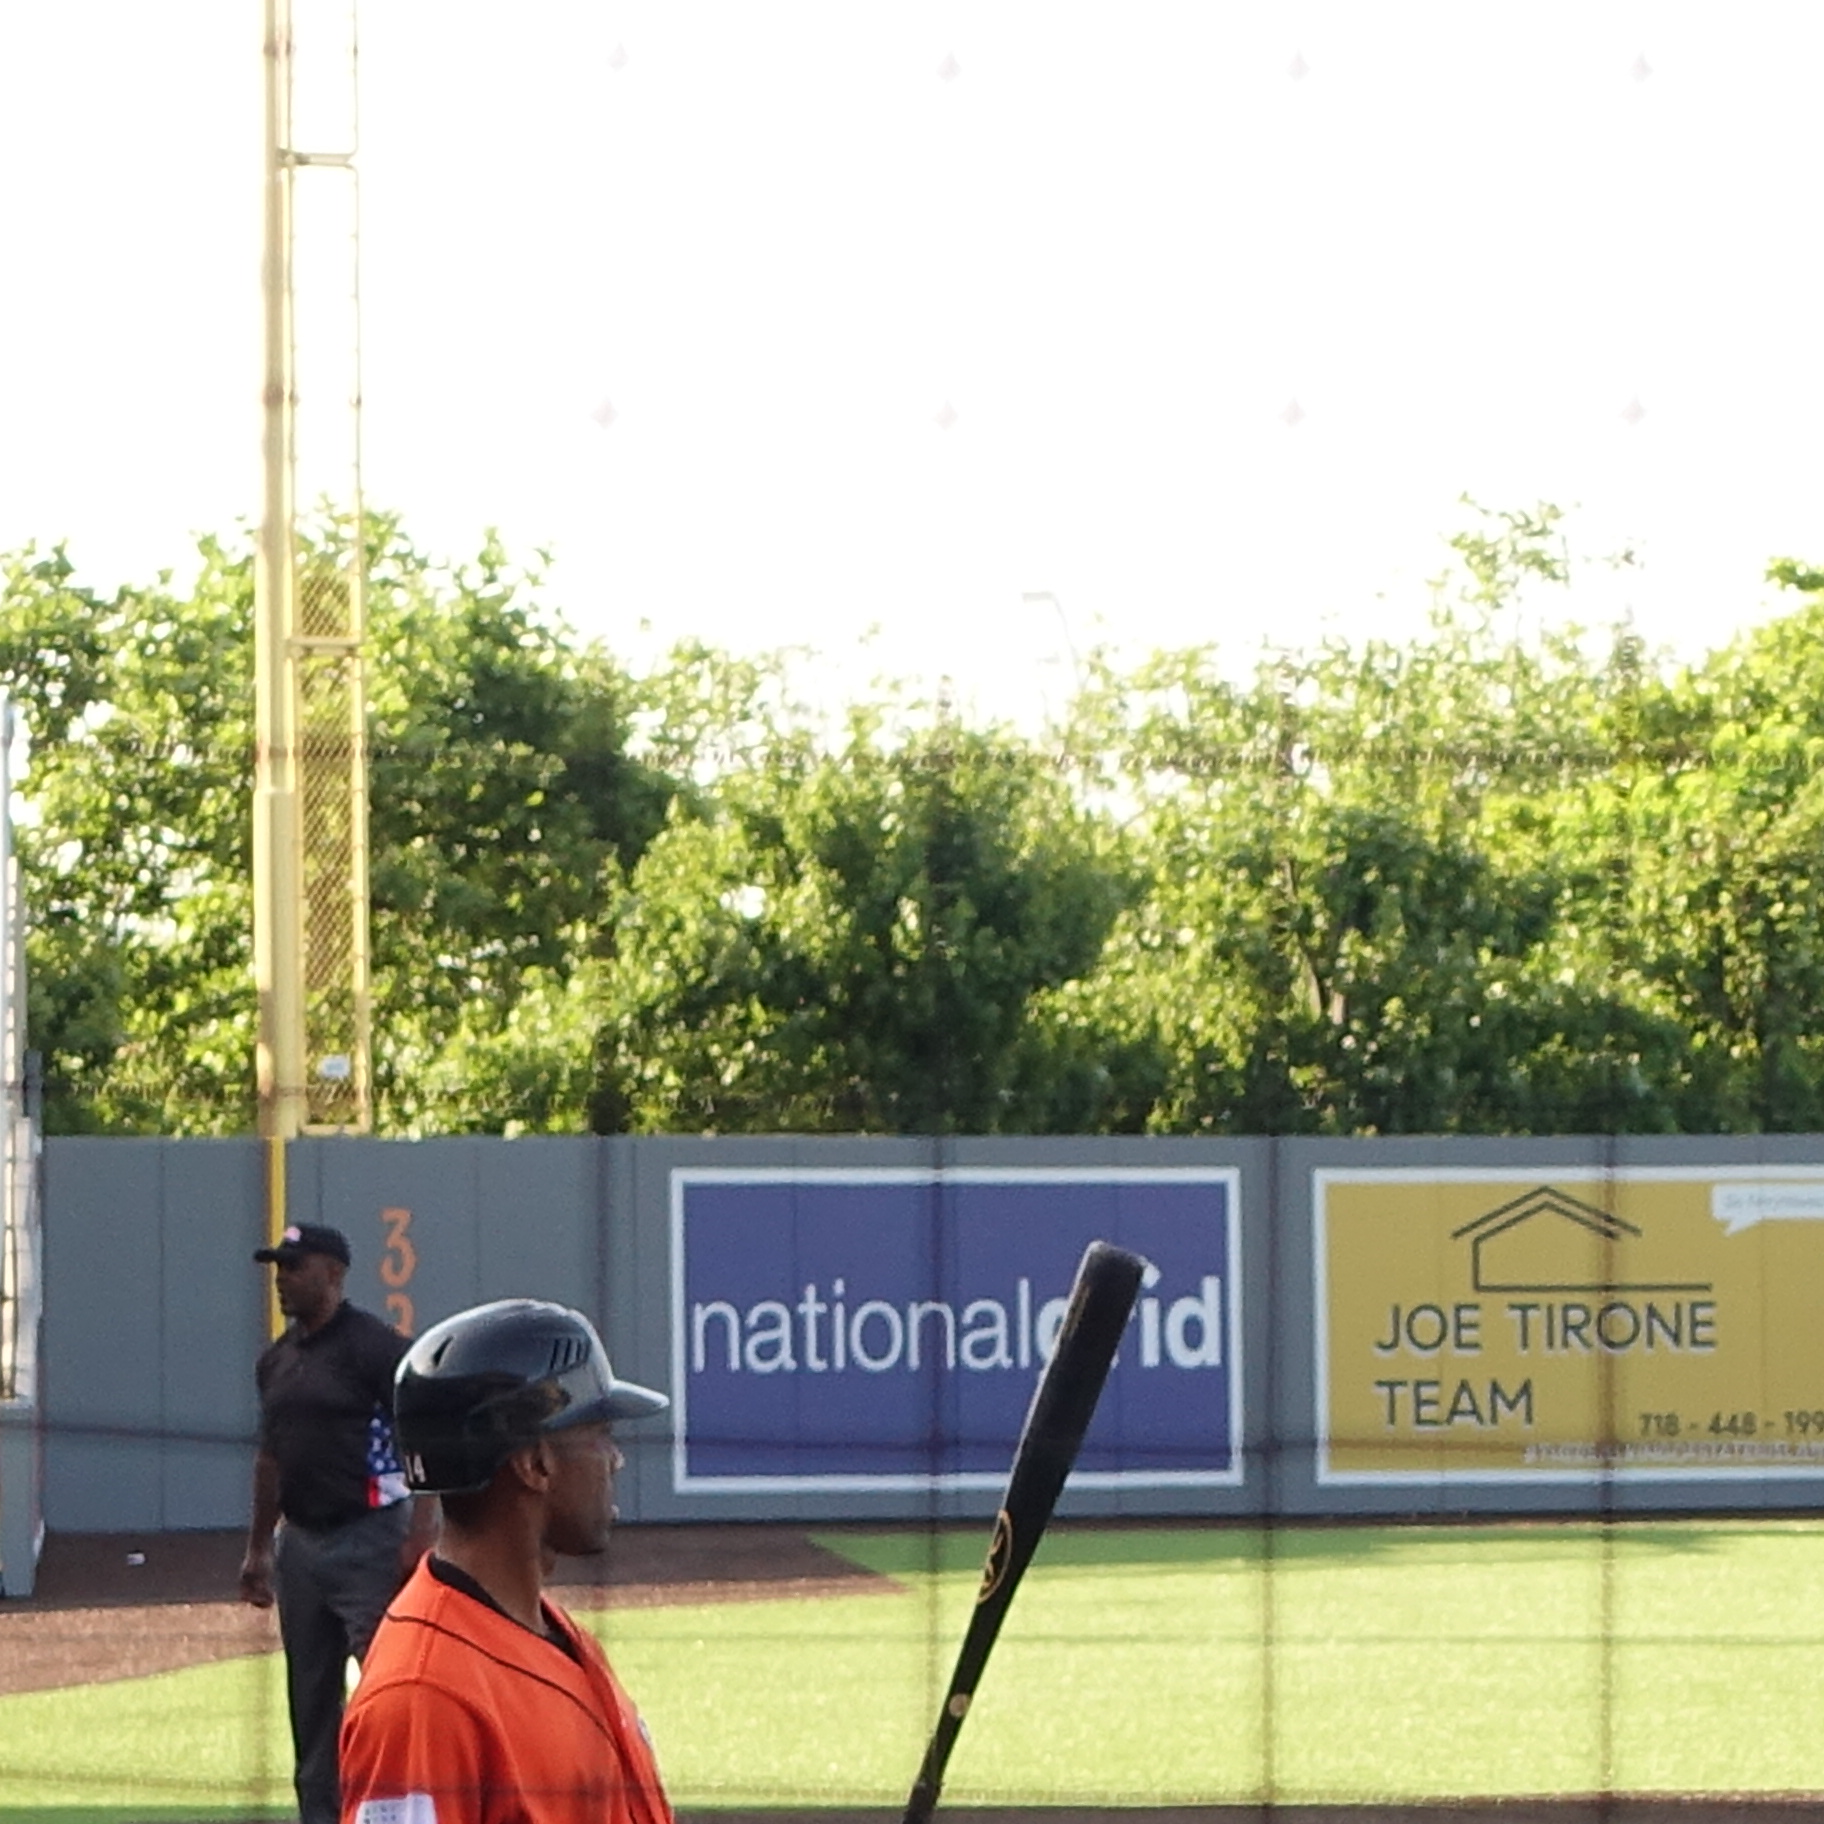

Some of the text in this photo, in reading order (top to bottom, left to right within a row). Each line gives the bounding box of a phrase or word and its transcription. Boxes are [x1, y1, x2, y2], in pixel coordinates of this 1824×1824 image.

[691, 1274, 1222, 1373] nationalid
[1374, 1301, 1719, 1354] JOE TIRONE
[1374, 1379, 1535, 1429] TEAM
